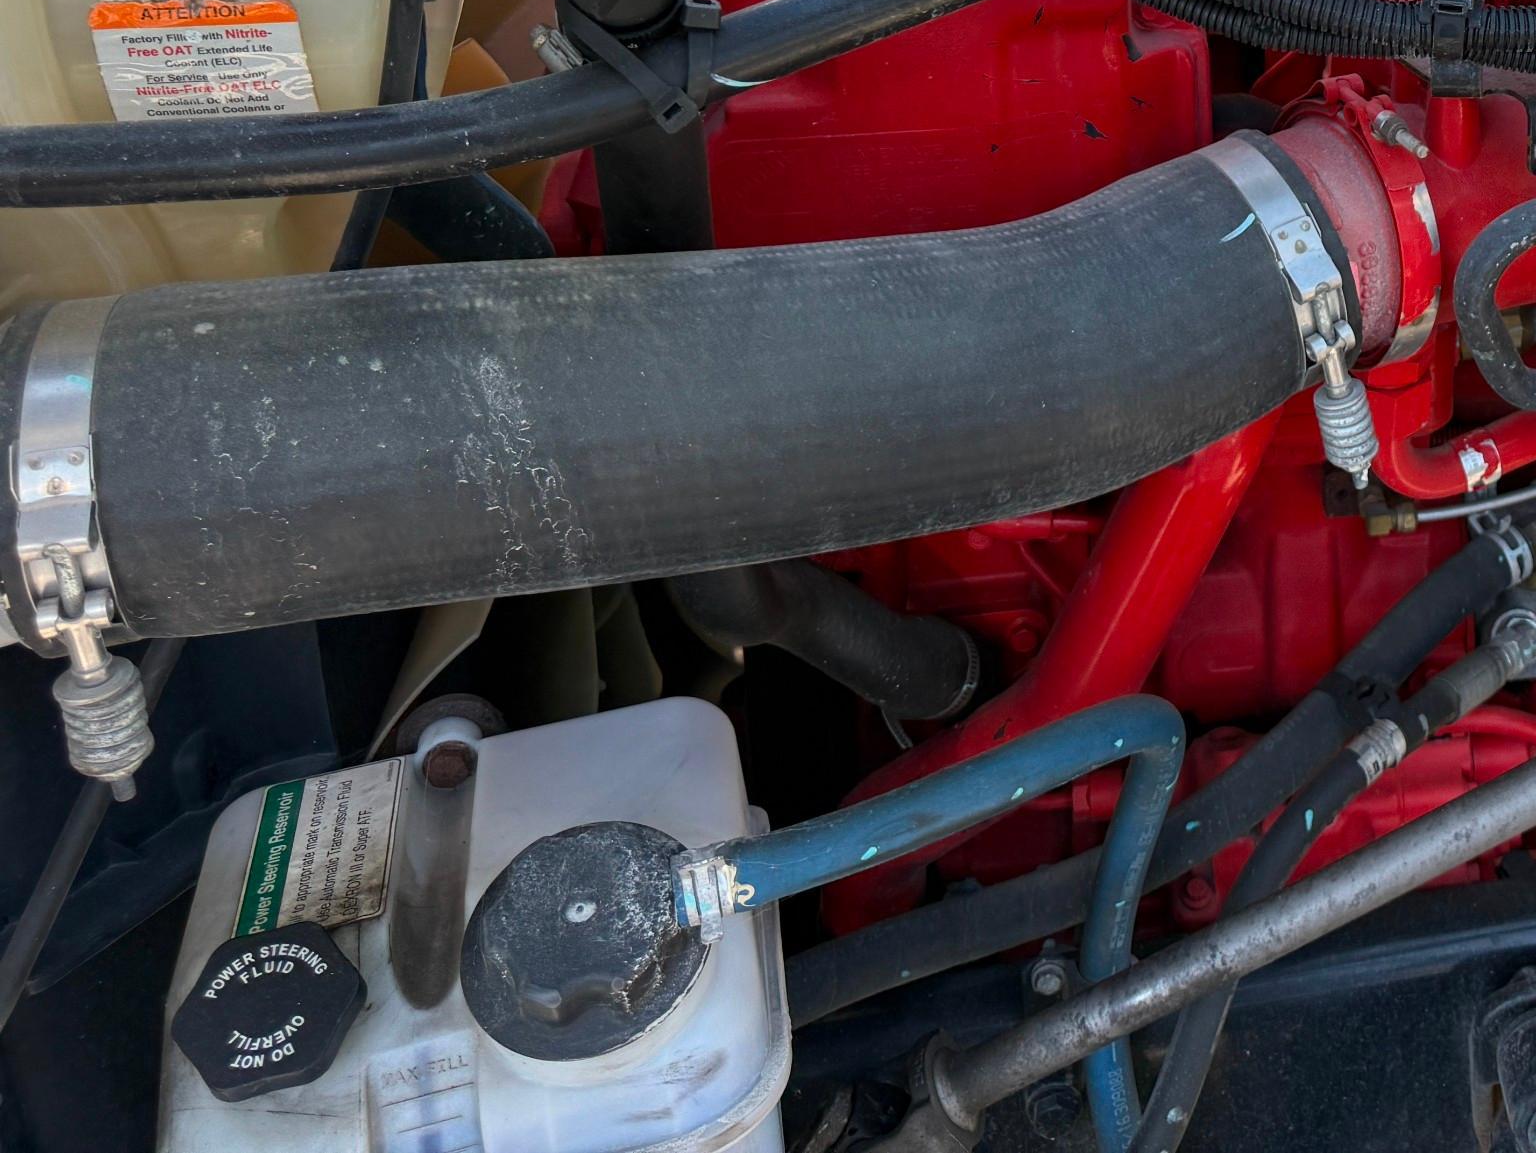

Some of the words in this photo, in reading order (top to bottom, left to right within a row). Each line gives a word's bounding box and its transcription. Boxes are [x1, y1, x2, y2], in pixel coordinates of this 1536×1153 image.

[140, 5, 245, 21] ATTENTION
[121, 34, 163, 45] Factory
[201, 31, 223, 41] with
[224, 28, 273, 39] Nitrite-
[127, 47, 160, 58] Free
[162, 45, 193, 57] OAT
[197, 44, 250, 56] Extended
[252, 43, 273, 53] Life
[211, 57, 242, 68] (ELC)
[146, 74, 164, 83] For
[167, 72, 209, 83] Service
[219, 71, 240, 80] Use
[218, 81, 249, 92] OAT
[253, 80, 281, 91] ELC
[146, 106, 220, 117] Conventional
[222, 104, 271, 114] Coolants
[313, 776, 330, 812] reservoir.
[338, 779, 353, 803] Fluid
[268, 791, 294, 845] Reservoir
[311, 812, 322, 826] on
[327, 802, 349, 858] Transmission
[306, 825, 319, 854] mark
[353, 827, 372, 853] Super
[356, 852, 366, 861] or
[261, 845, 286, 895] Steering
[298, 849, 315, 897] appropriate
[320, 855, 340, 901] Automatic
[343, 872, 361, 917] DEXRON
[249, 899, 272, 935] Power
[294, 903, 305, 913] to
[317, 904, 332, 922] Use
[205, 952, 256, 998] POWER
[260, 943, 327, 975] STEERING
[240, 960, 294, 984] FLUID
[228, 1015, 305, 1050] OVERFILL
[230, 1054, 265, 1069] NOT
[271, 1042, 295, 1061] DO
